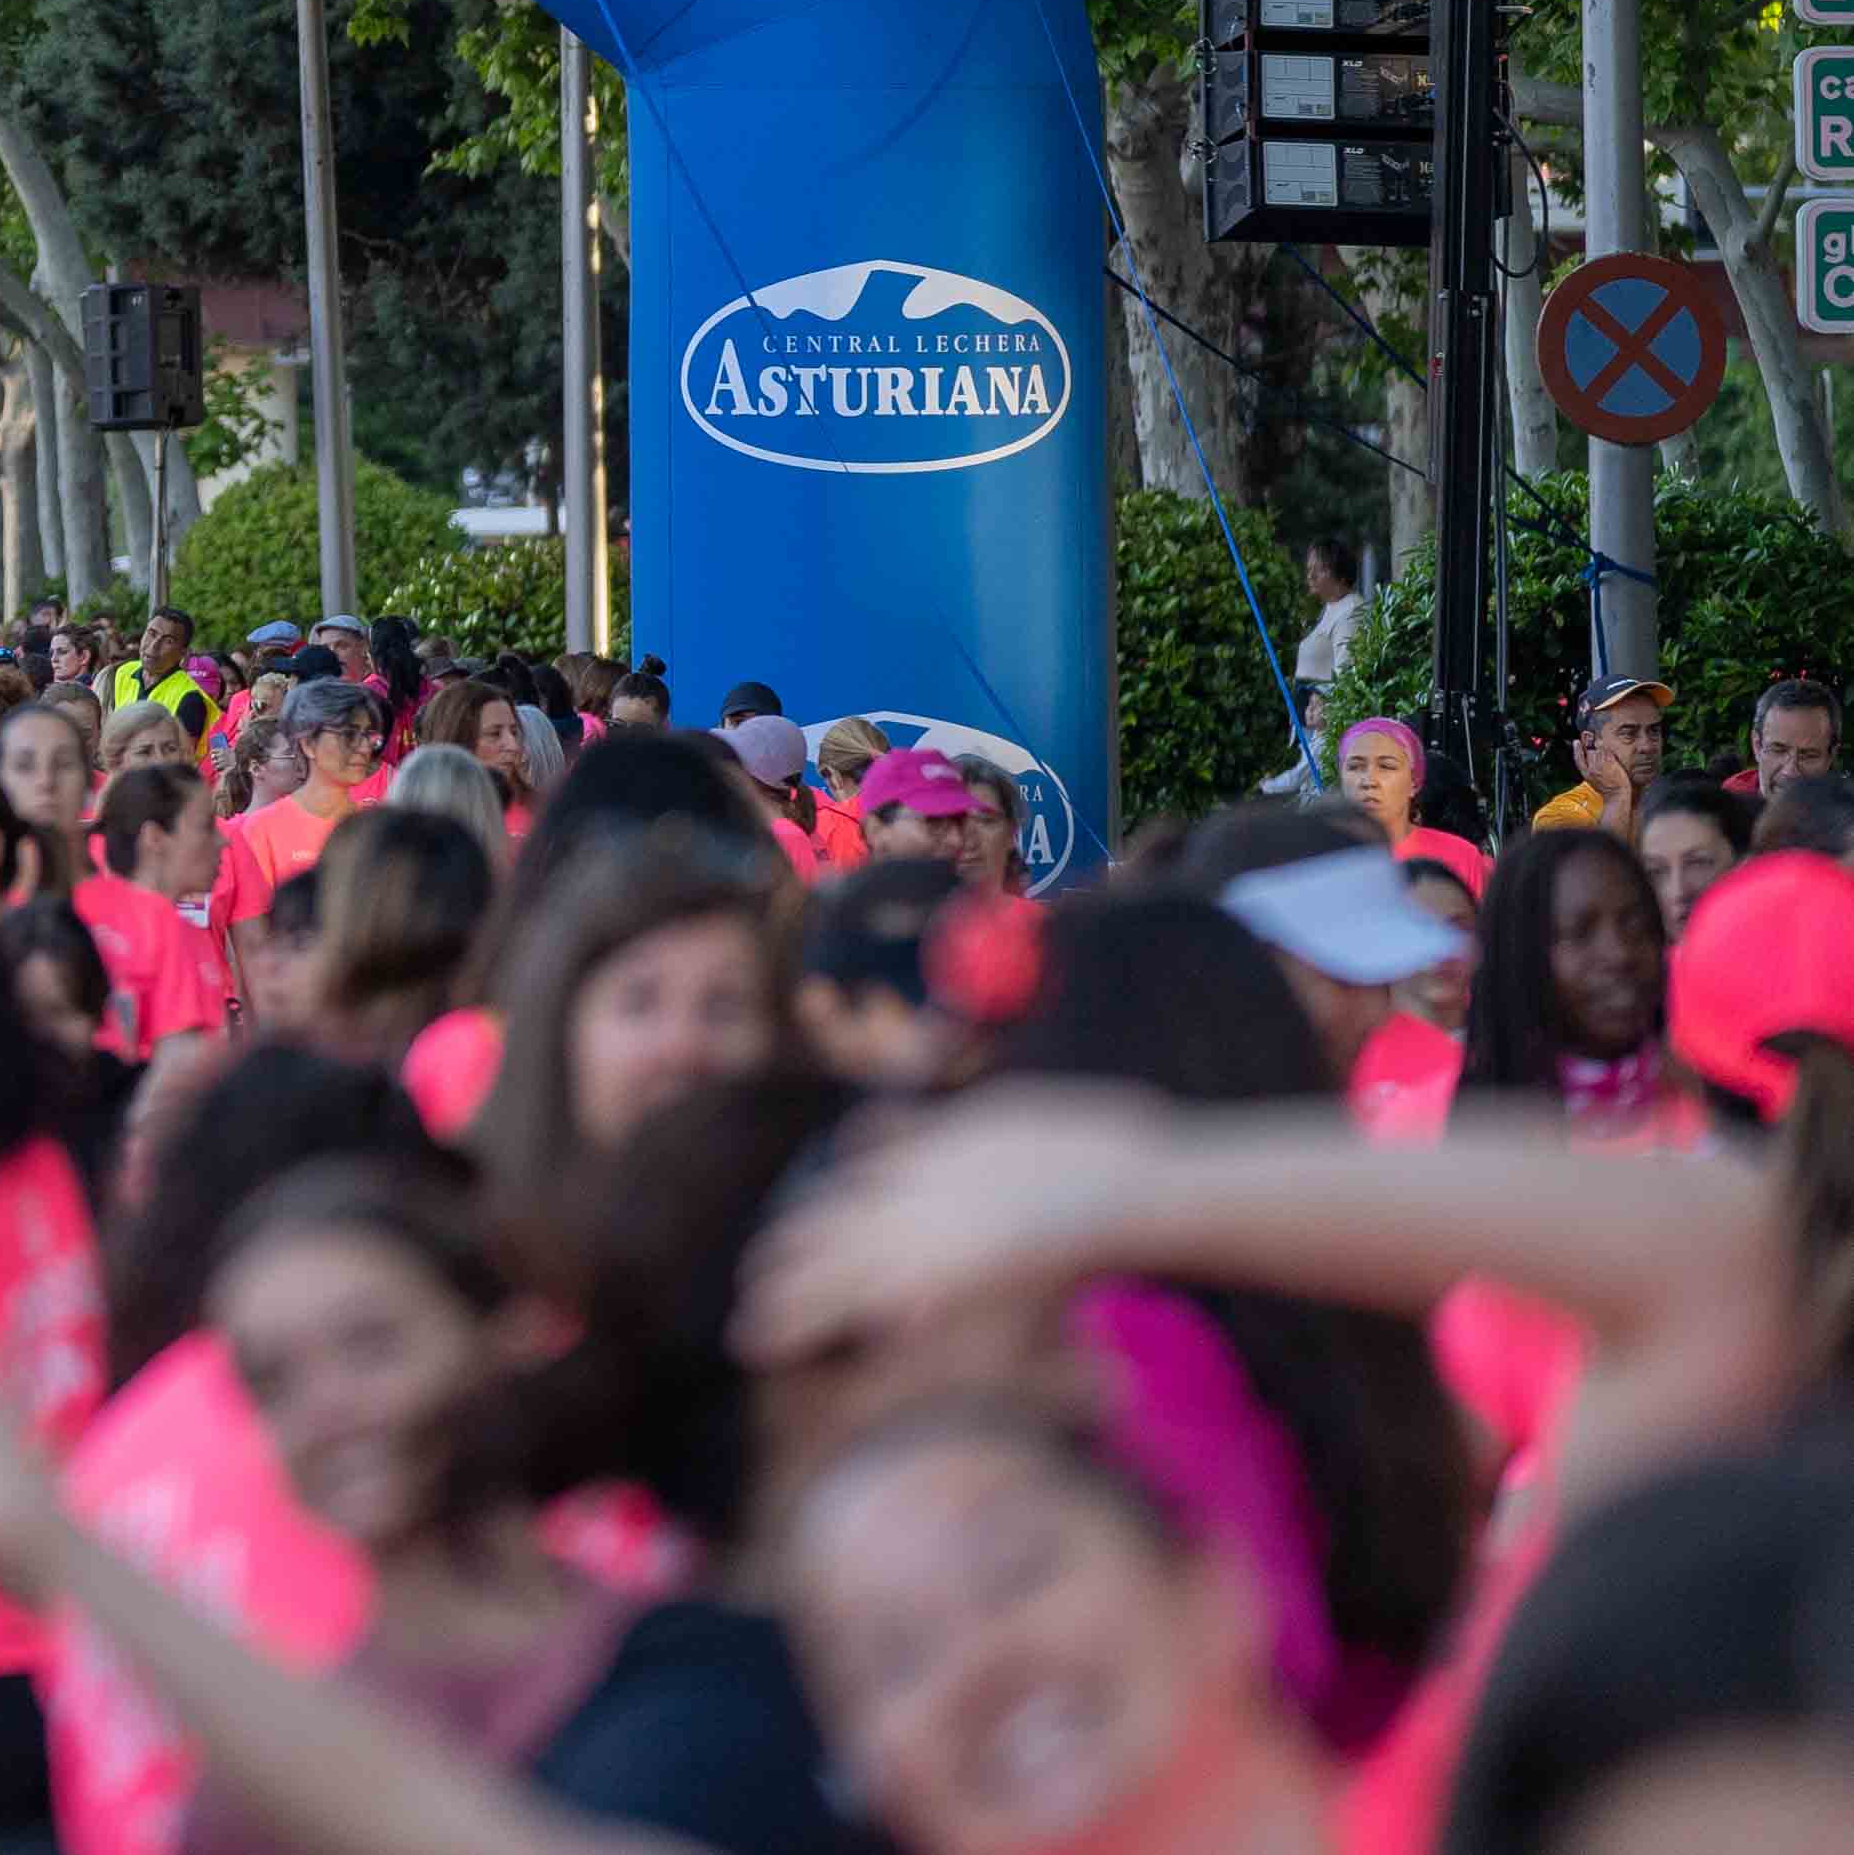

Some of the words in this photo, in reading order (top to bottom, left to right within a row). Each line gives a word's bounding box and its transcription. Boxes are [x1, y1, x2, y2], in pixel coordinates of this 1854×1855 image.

[762, 334, 900, 353] CENTRAL
[916, 334, 1041, 353] LECHERA
[705, 338, 1051, 417] ASTURIANA
